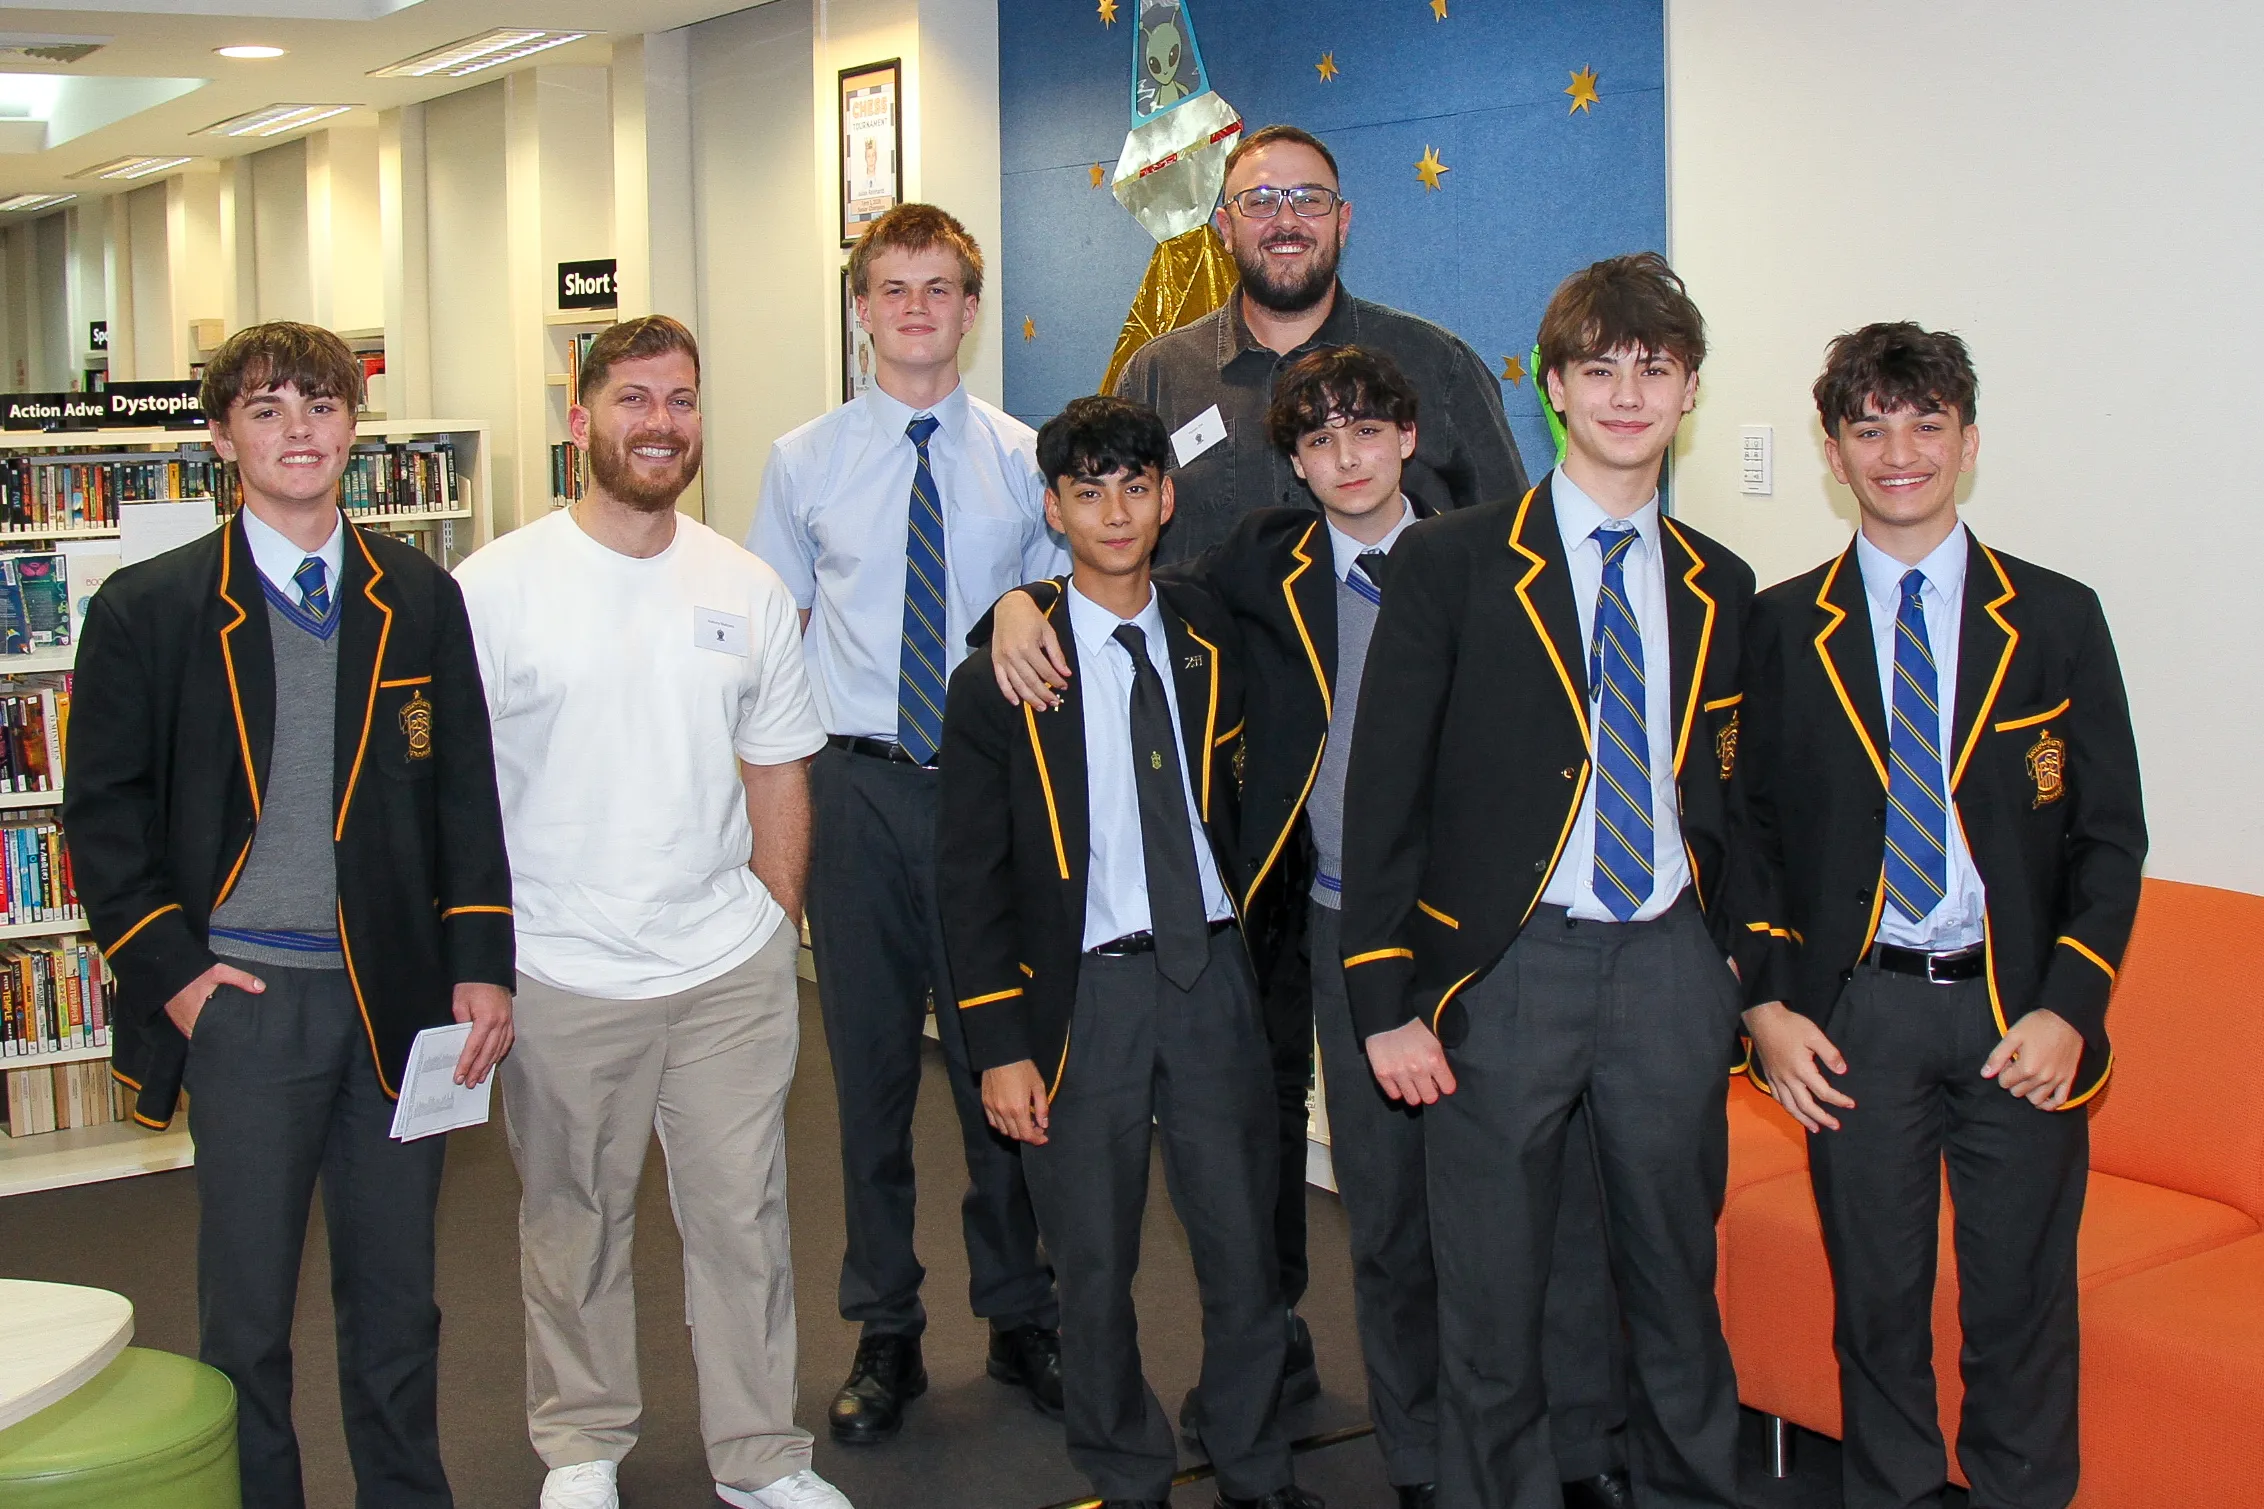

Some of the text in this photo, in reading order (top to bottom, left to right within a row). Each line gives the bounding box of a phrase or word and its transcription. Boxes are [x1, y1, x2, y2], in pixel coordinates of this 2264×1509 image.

[853, 96, 887, 118] CHESS
[852, 117, 888, 131] TOURNAMENT
[565, 272, 610, 296] Short
[9, 403, 60, 418] Action
[3, 990, 13, 1021] TEMPLE
